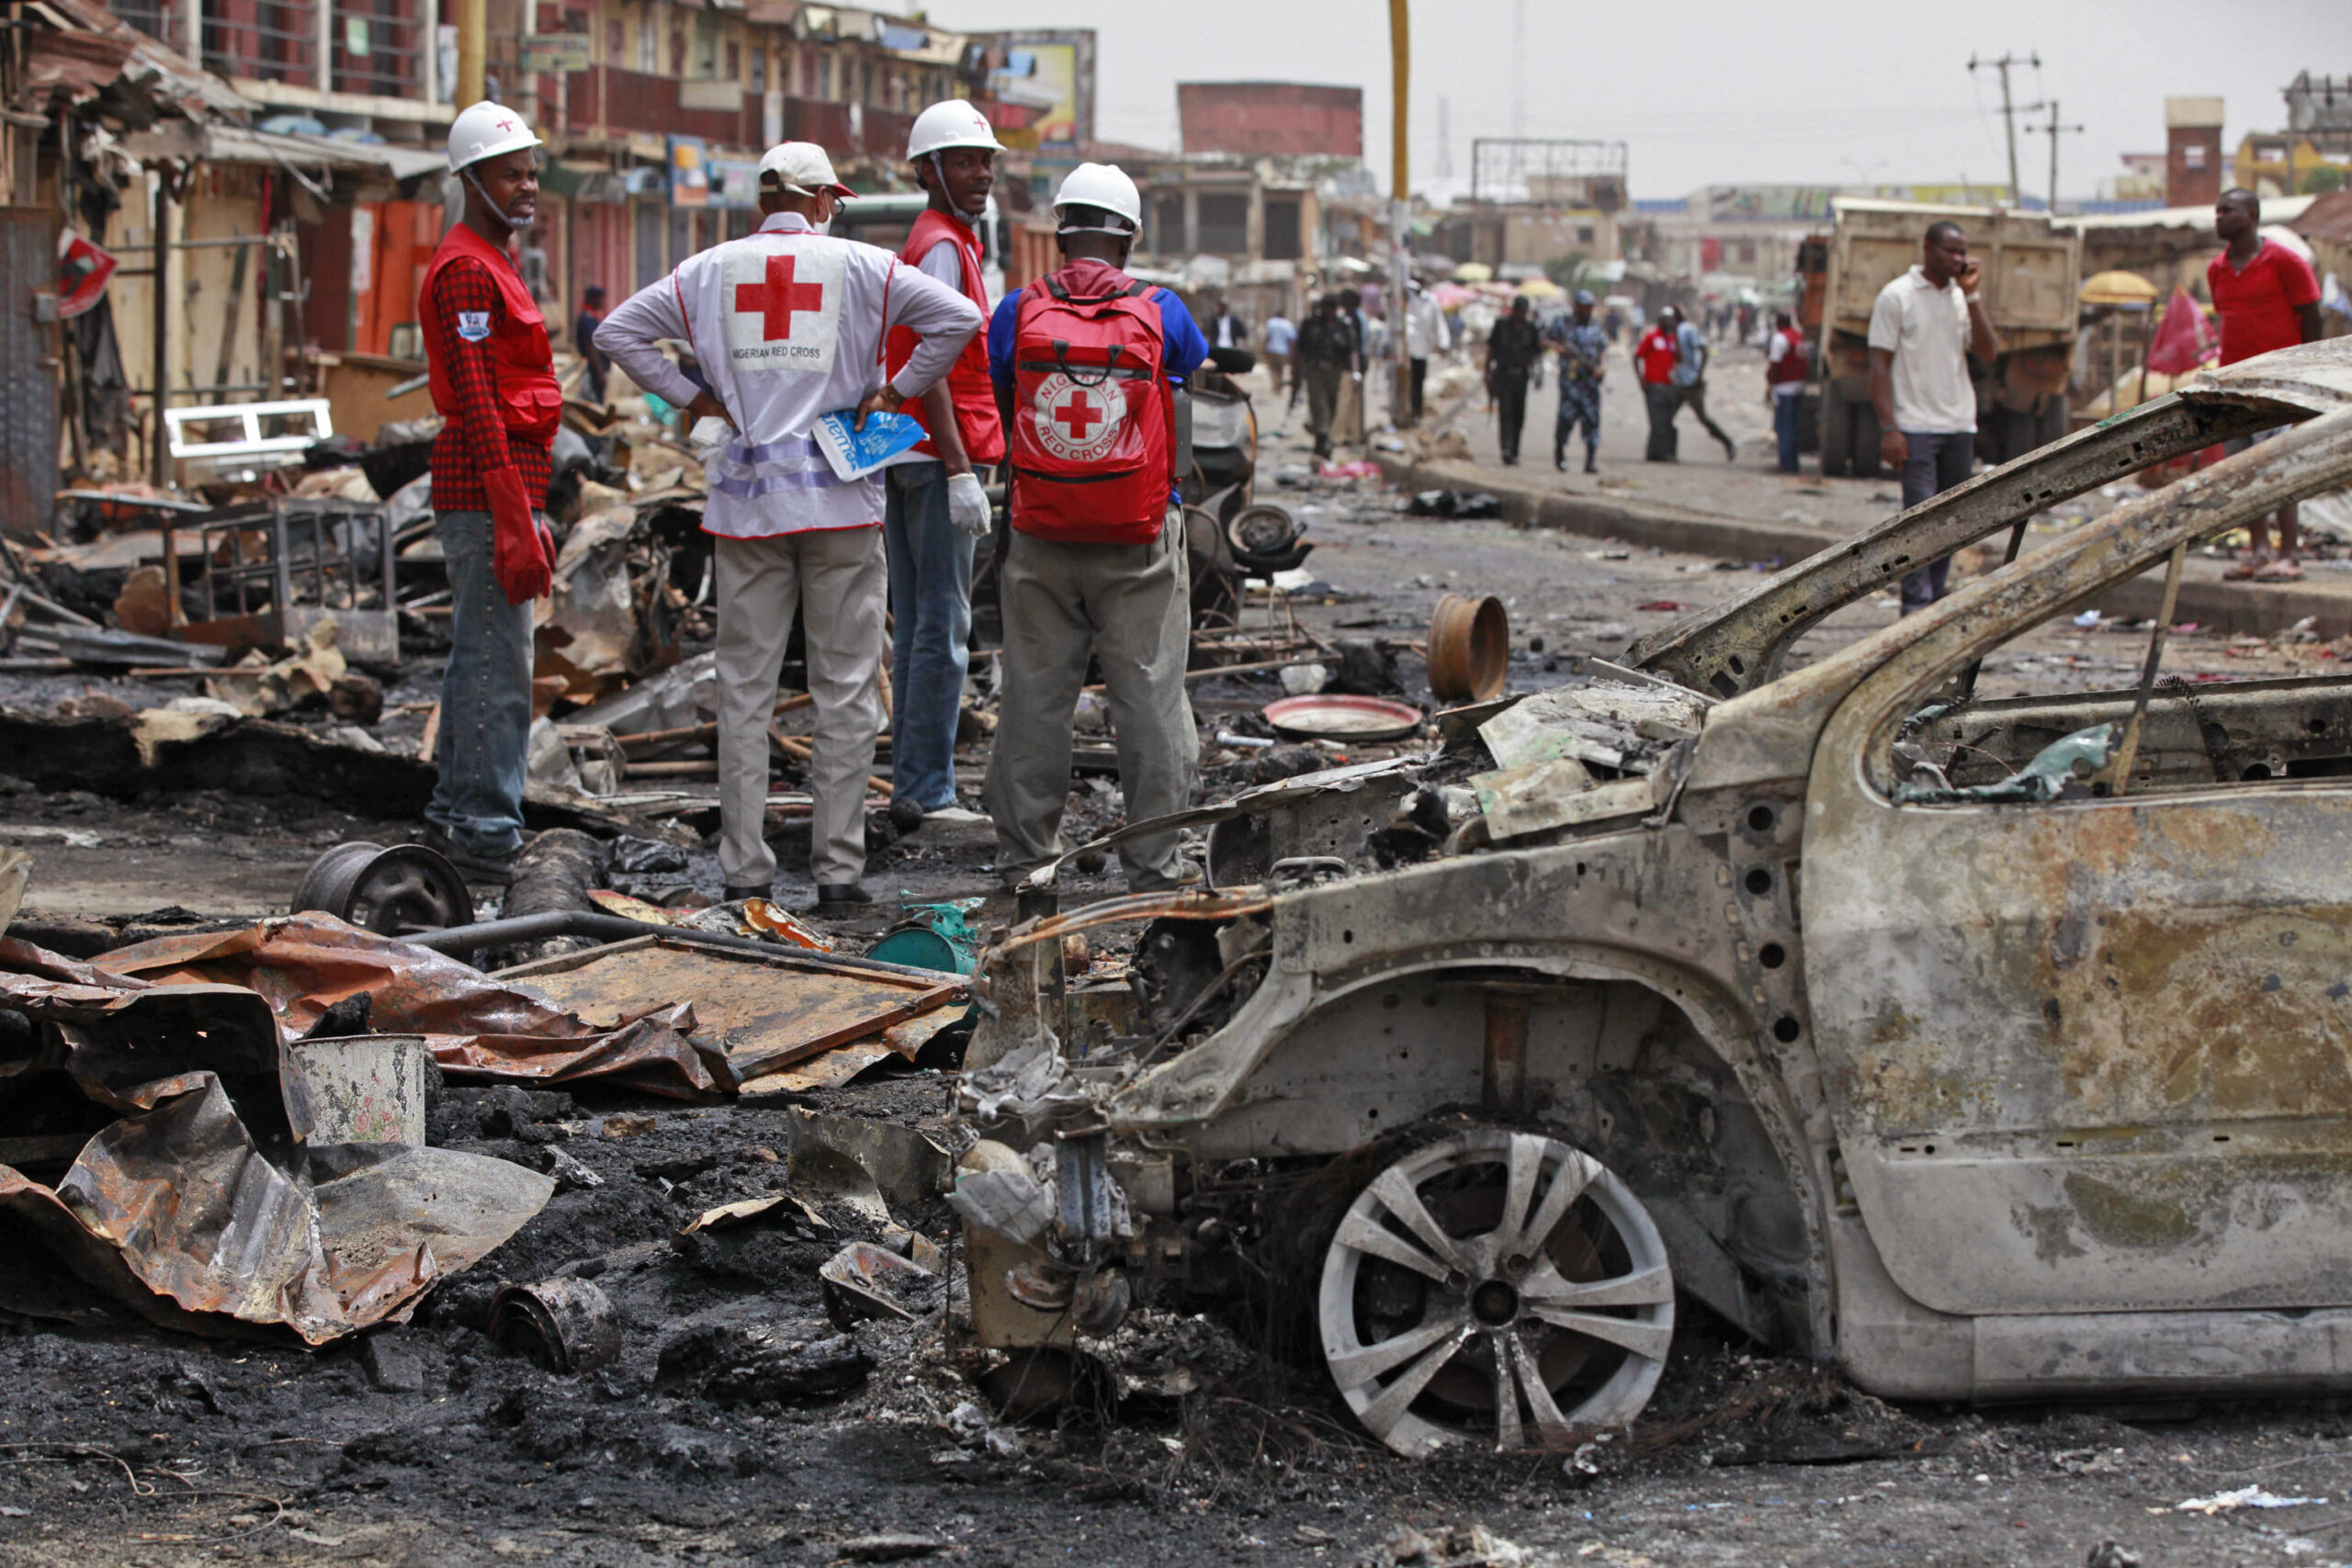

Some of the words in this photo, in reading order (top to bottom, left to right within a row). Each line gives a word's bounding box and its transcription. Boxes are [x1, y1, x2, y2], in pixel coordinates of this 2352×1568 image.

[772, 346, 788, 357] RED
[790, 347, 820, 359] CROSS
[1041, 374, 1118, 401] NIGRIAN
[1040, 425, 1065, 454] RED
[1069, 429, 1118, 460] CROSS
